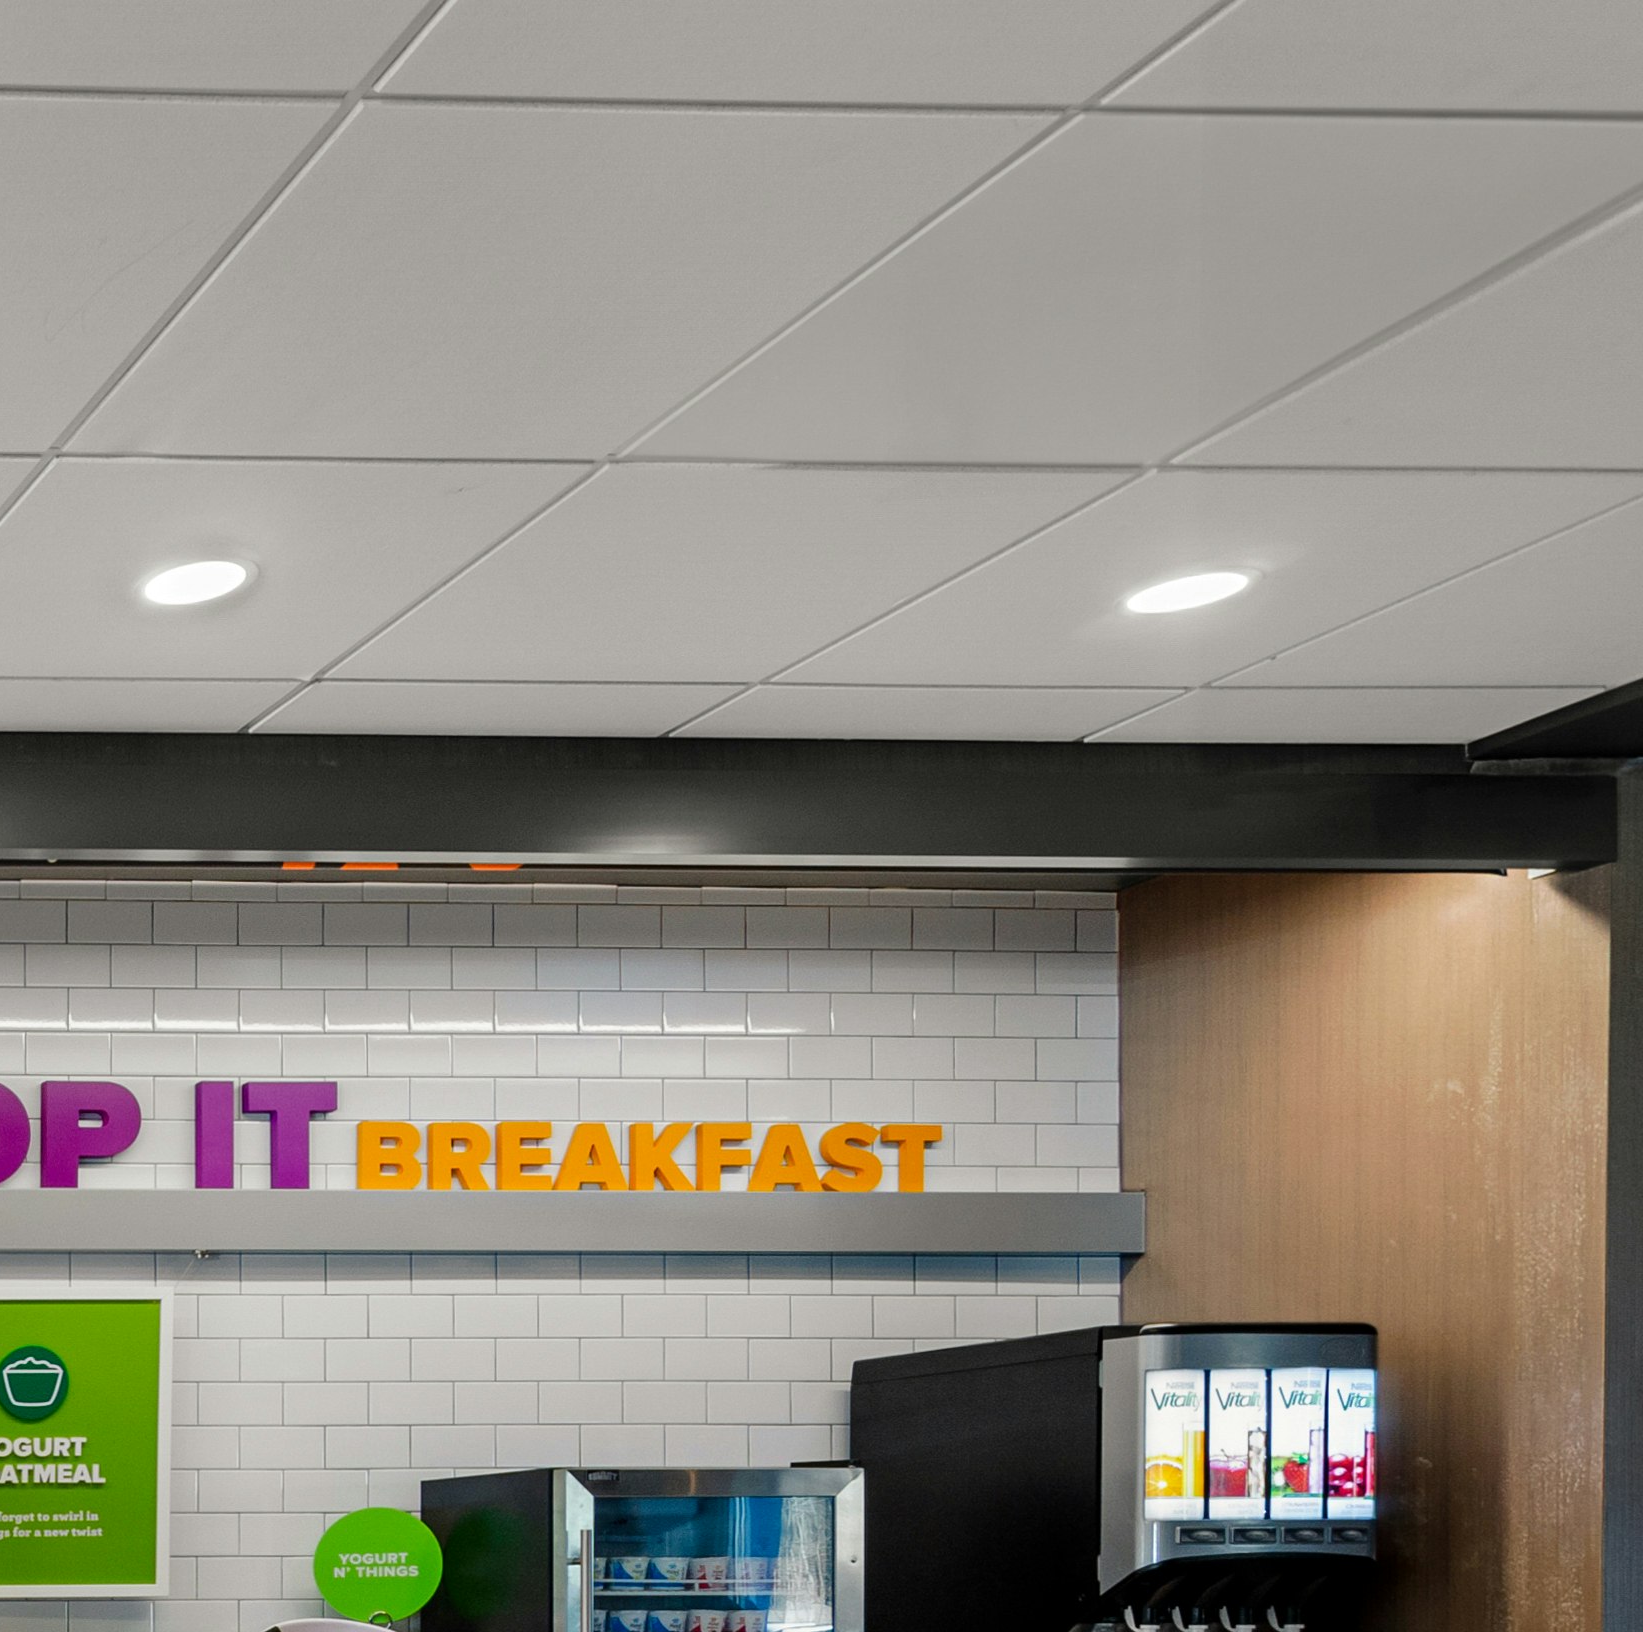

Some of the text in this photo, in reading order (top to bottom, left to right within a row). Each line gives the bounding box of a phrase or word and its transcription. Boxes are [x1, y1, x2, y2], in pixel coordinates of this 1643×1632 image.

[195, 1081, 338, 1188] IT
[356, 1121, 942, 1191] BREAKFAST
[37, 1512, 50, 1522] to
[52, 1510, 84, 1521] swirl
[86, 1511, 99, 1521] in
[13, 1527, 31, 1537] for
[34, 1529, 41, 1537] a
[44, 1529, 70, 1537] new
[71, 1526, 103, 1536] twist
[338, 1552, 409, 1565] YOGURT
[356, 1565, 419, 1578] THINGS
